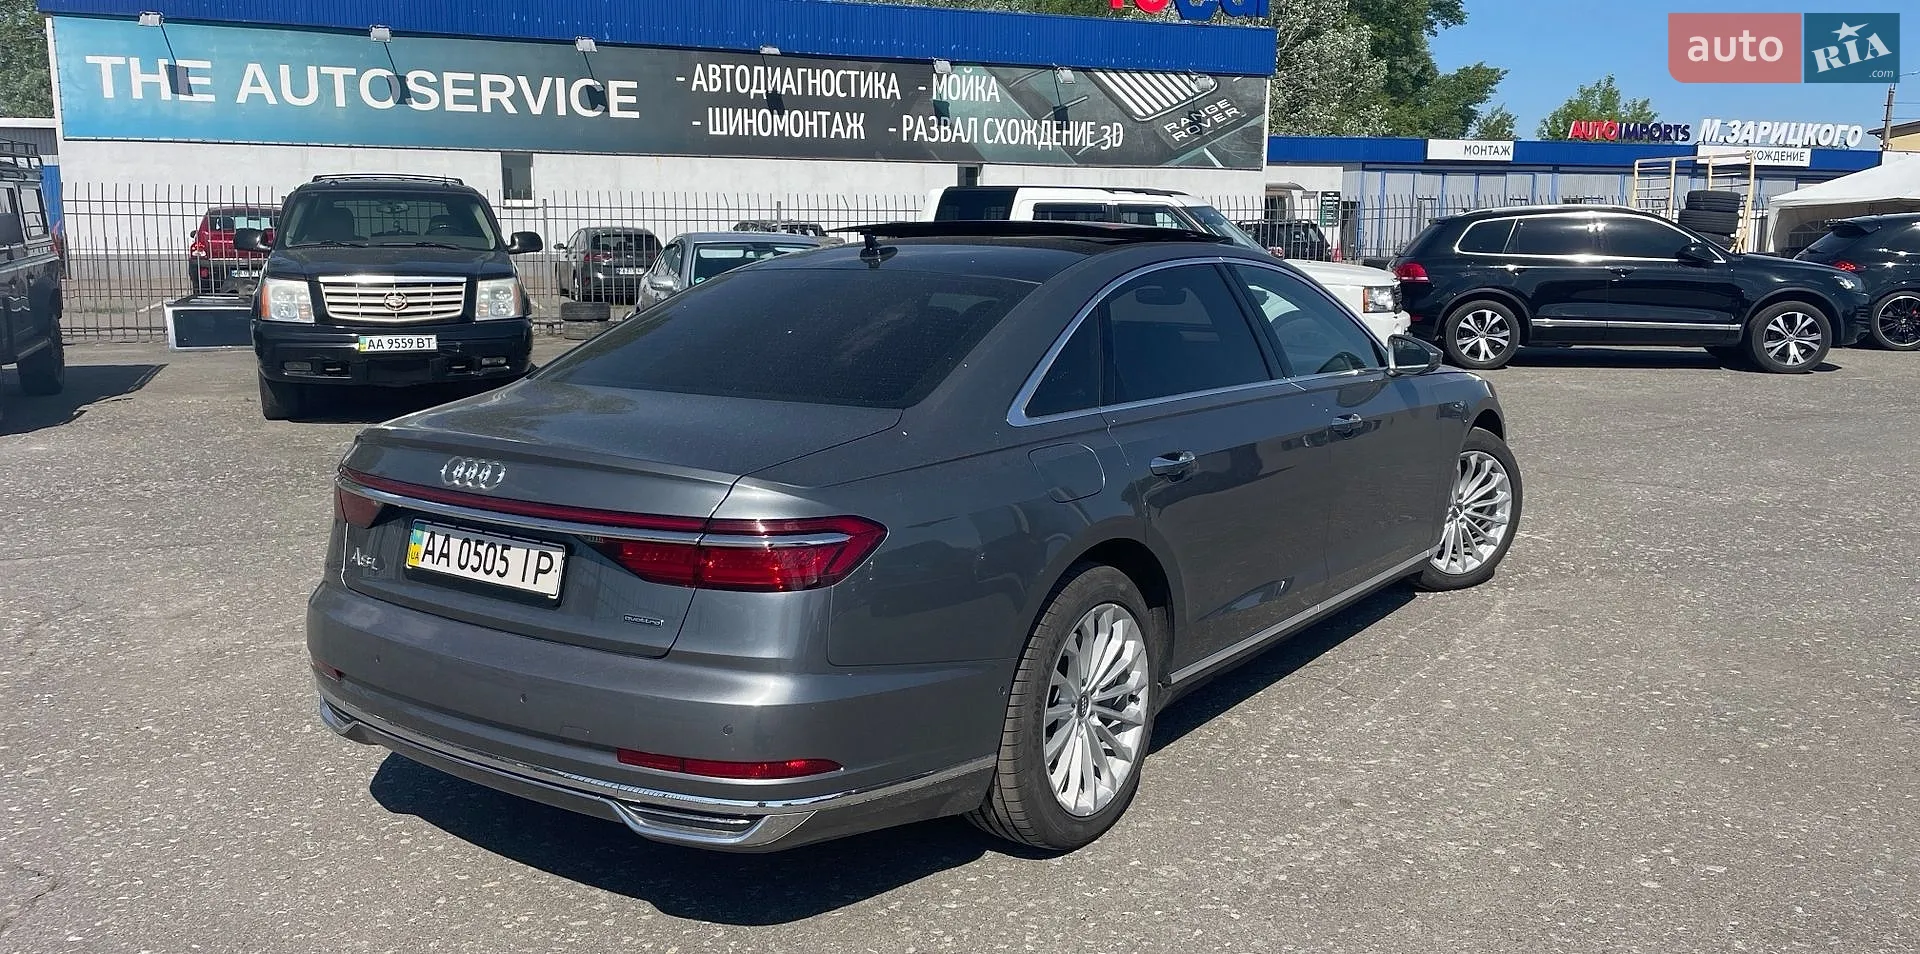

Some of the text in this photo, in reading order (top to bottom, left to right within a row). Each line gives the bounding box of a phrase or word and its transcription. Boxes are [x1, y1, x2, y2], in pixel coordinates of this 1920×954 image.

[85, 55, 640, 119] THE AUTOSERVICE
[691, 63, 901, 100] АВТОДИАГНОСТИКА
[932, 67, 1000, 102] МОЙКА
[708, 107, 866, 140] ШИНОМОНТАЖ
[902, 114, 978, 143] РАЗВАЛ
[983, 118, 1096, 150] СХОЖДЕНИЕ
[1100, 122, 1124, 150] 3D
[1163, 99, 1231, 133] RANGE
[1172, 107, 1241, 141] ROVER
[1699, 119, 1863, 147] М.ЗАРИЦКОГО
[1464, 145, 1511, 156] МОНТАЖ
[367, 337, 433, 350] AA 9559 BT
[421, 530, 450, 567] AA
[457, 537, 511, 578] 0505
